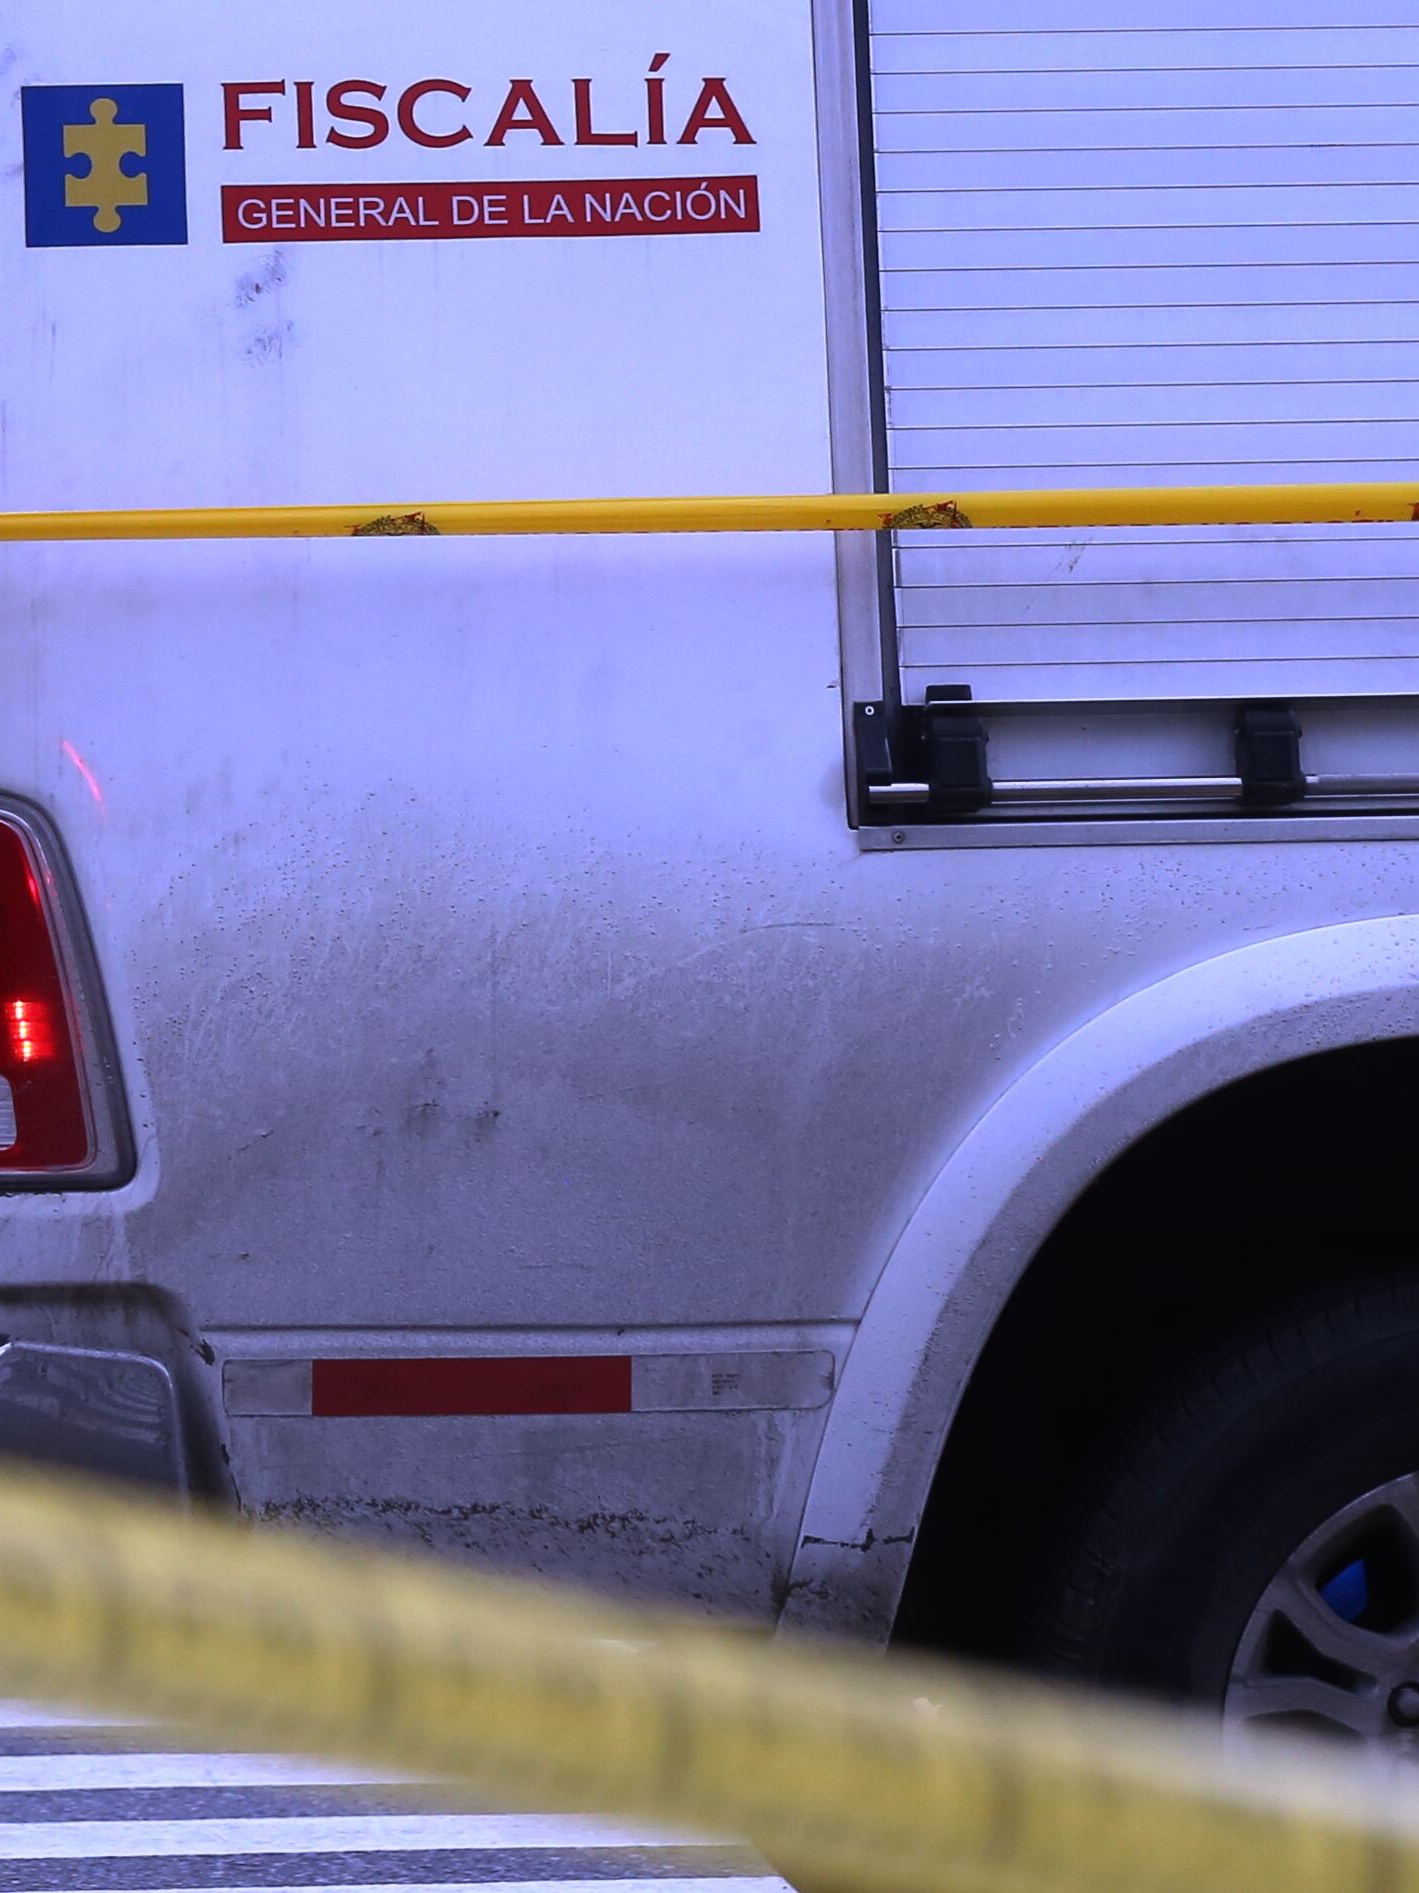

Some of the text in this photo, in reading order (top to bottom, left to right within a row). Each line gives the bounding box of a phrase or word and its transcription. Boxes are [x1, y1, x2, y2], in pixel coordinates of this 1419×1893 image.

[220, 53, 758, 150] FISCALÍA
[236, 181, 747, 230] GENERAL DE LA NACIÓN
